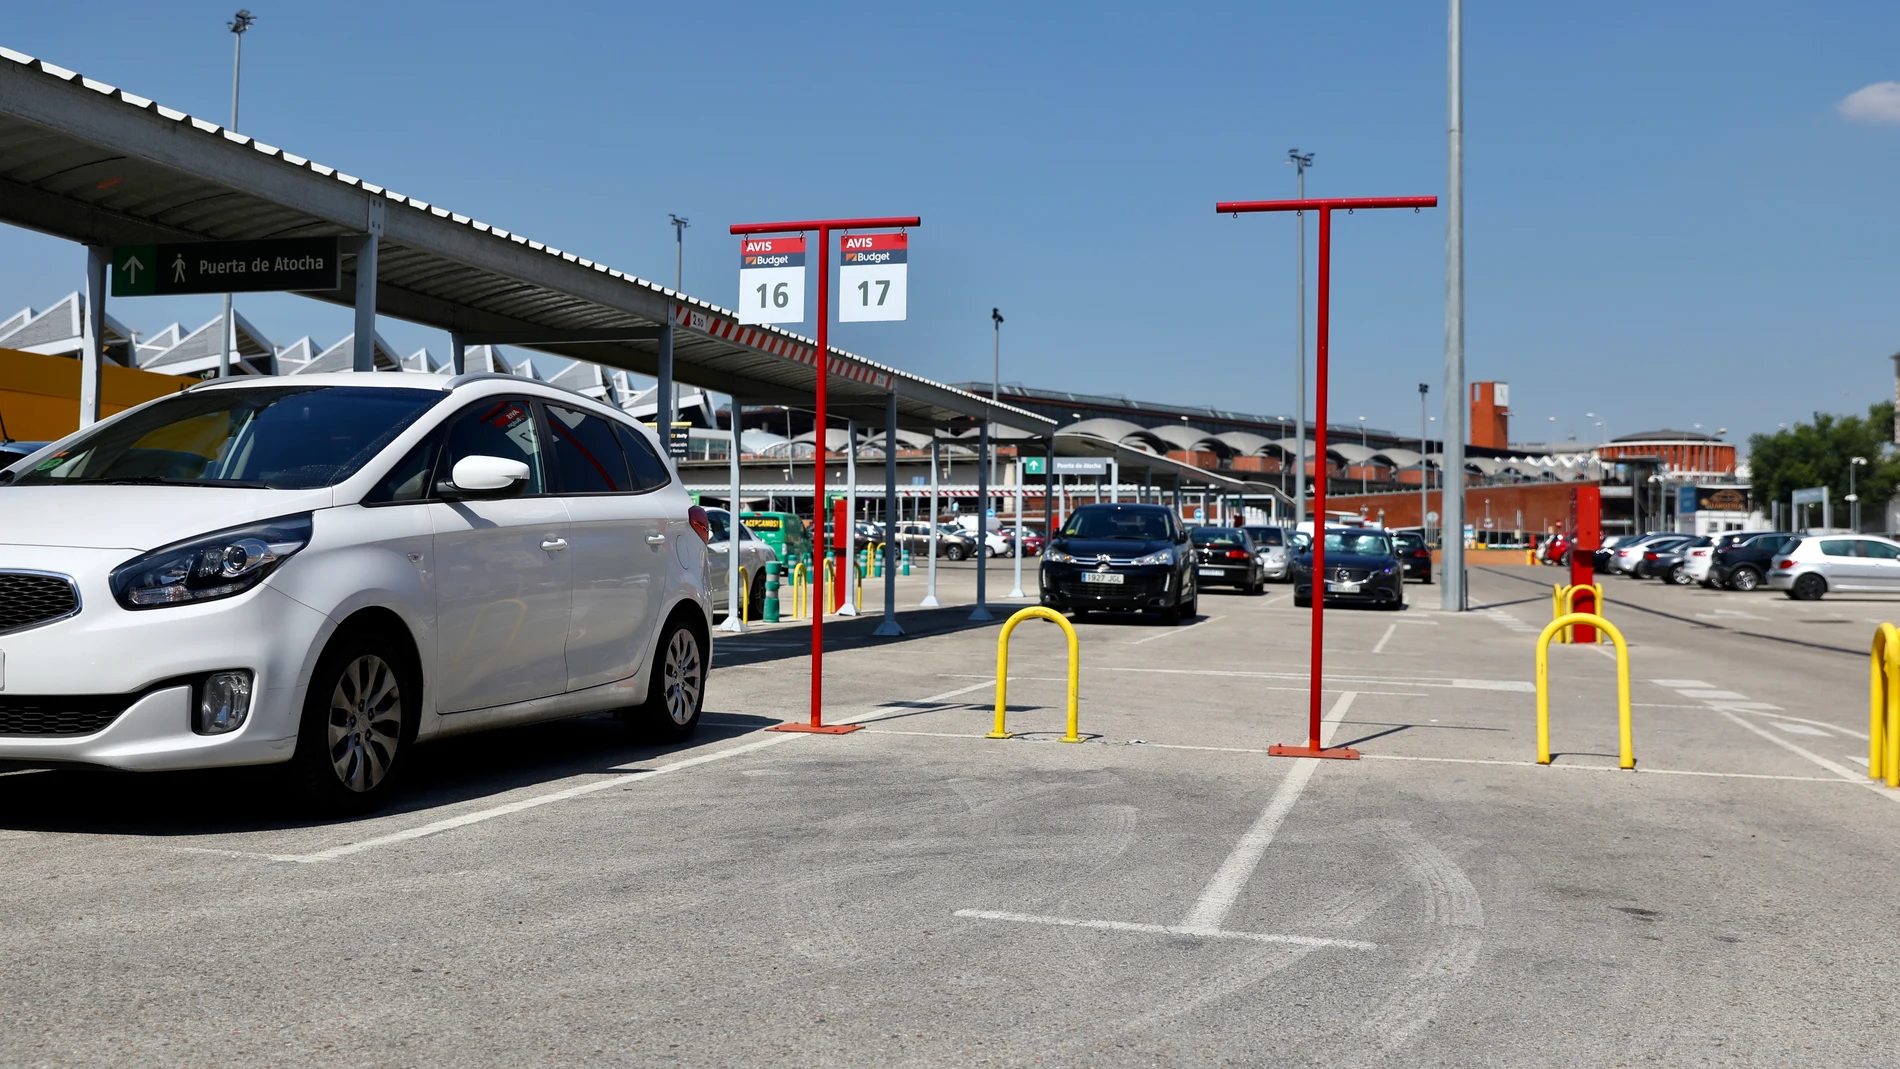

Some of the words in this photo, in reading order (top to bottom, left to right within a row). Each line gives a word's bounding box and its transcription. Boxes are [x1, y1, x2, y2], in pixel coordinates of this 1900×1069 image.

[746, 242, 772, 252] AVIS
[846, 238, 872, 248] AVIS
[757, 255, 788, 266] Budget
[858, 252, 890, 264] Budget
[200, 259, 246, 274] Puerta
[251, 257, 269, 272] de
[274, 255, 324, 271] Atocha
[756, 282, 789, 309] 16
[857, 280, 890, 306] 17
[1087, 574, 1105, 582] 1927
